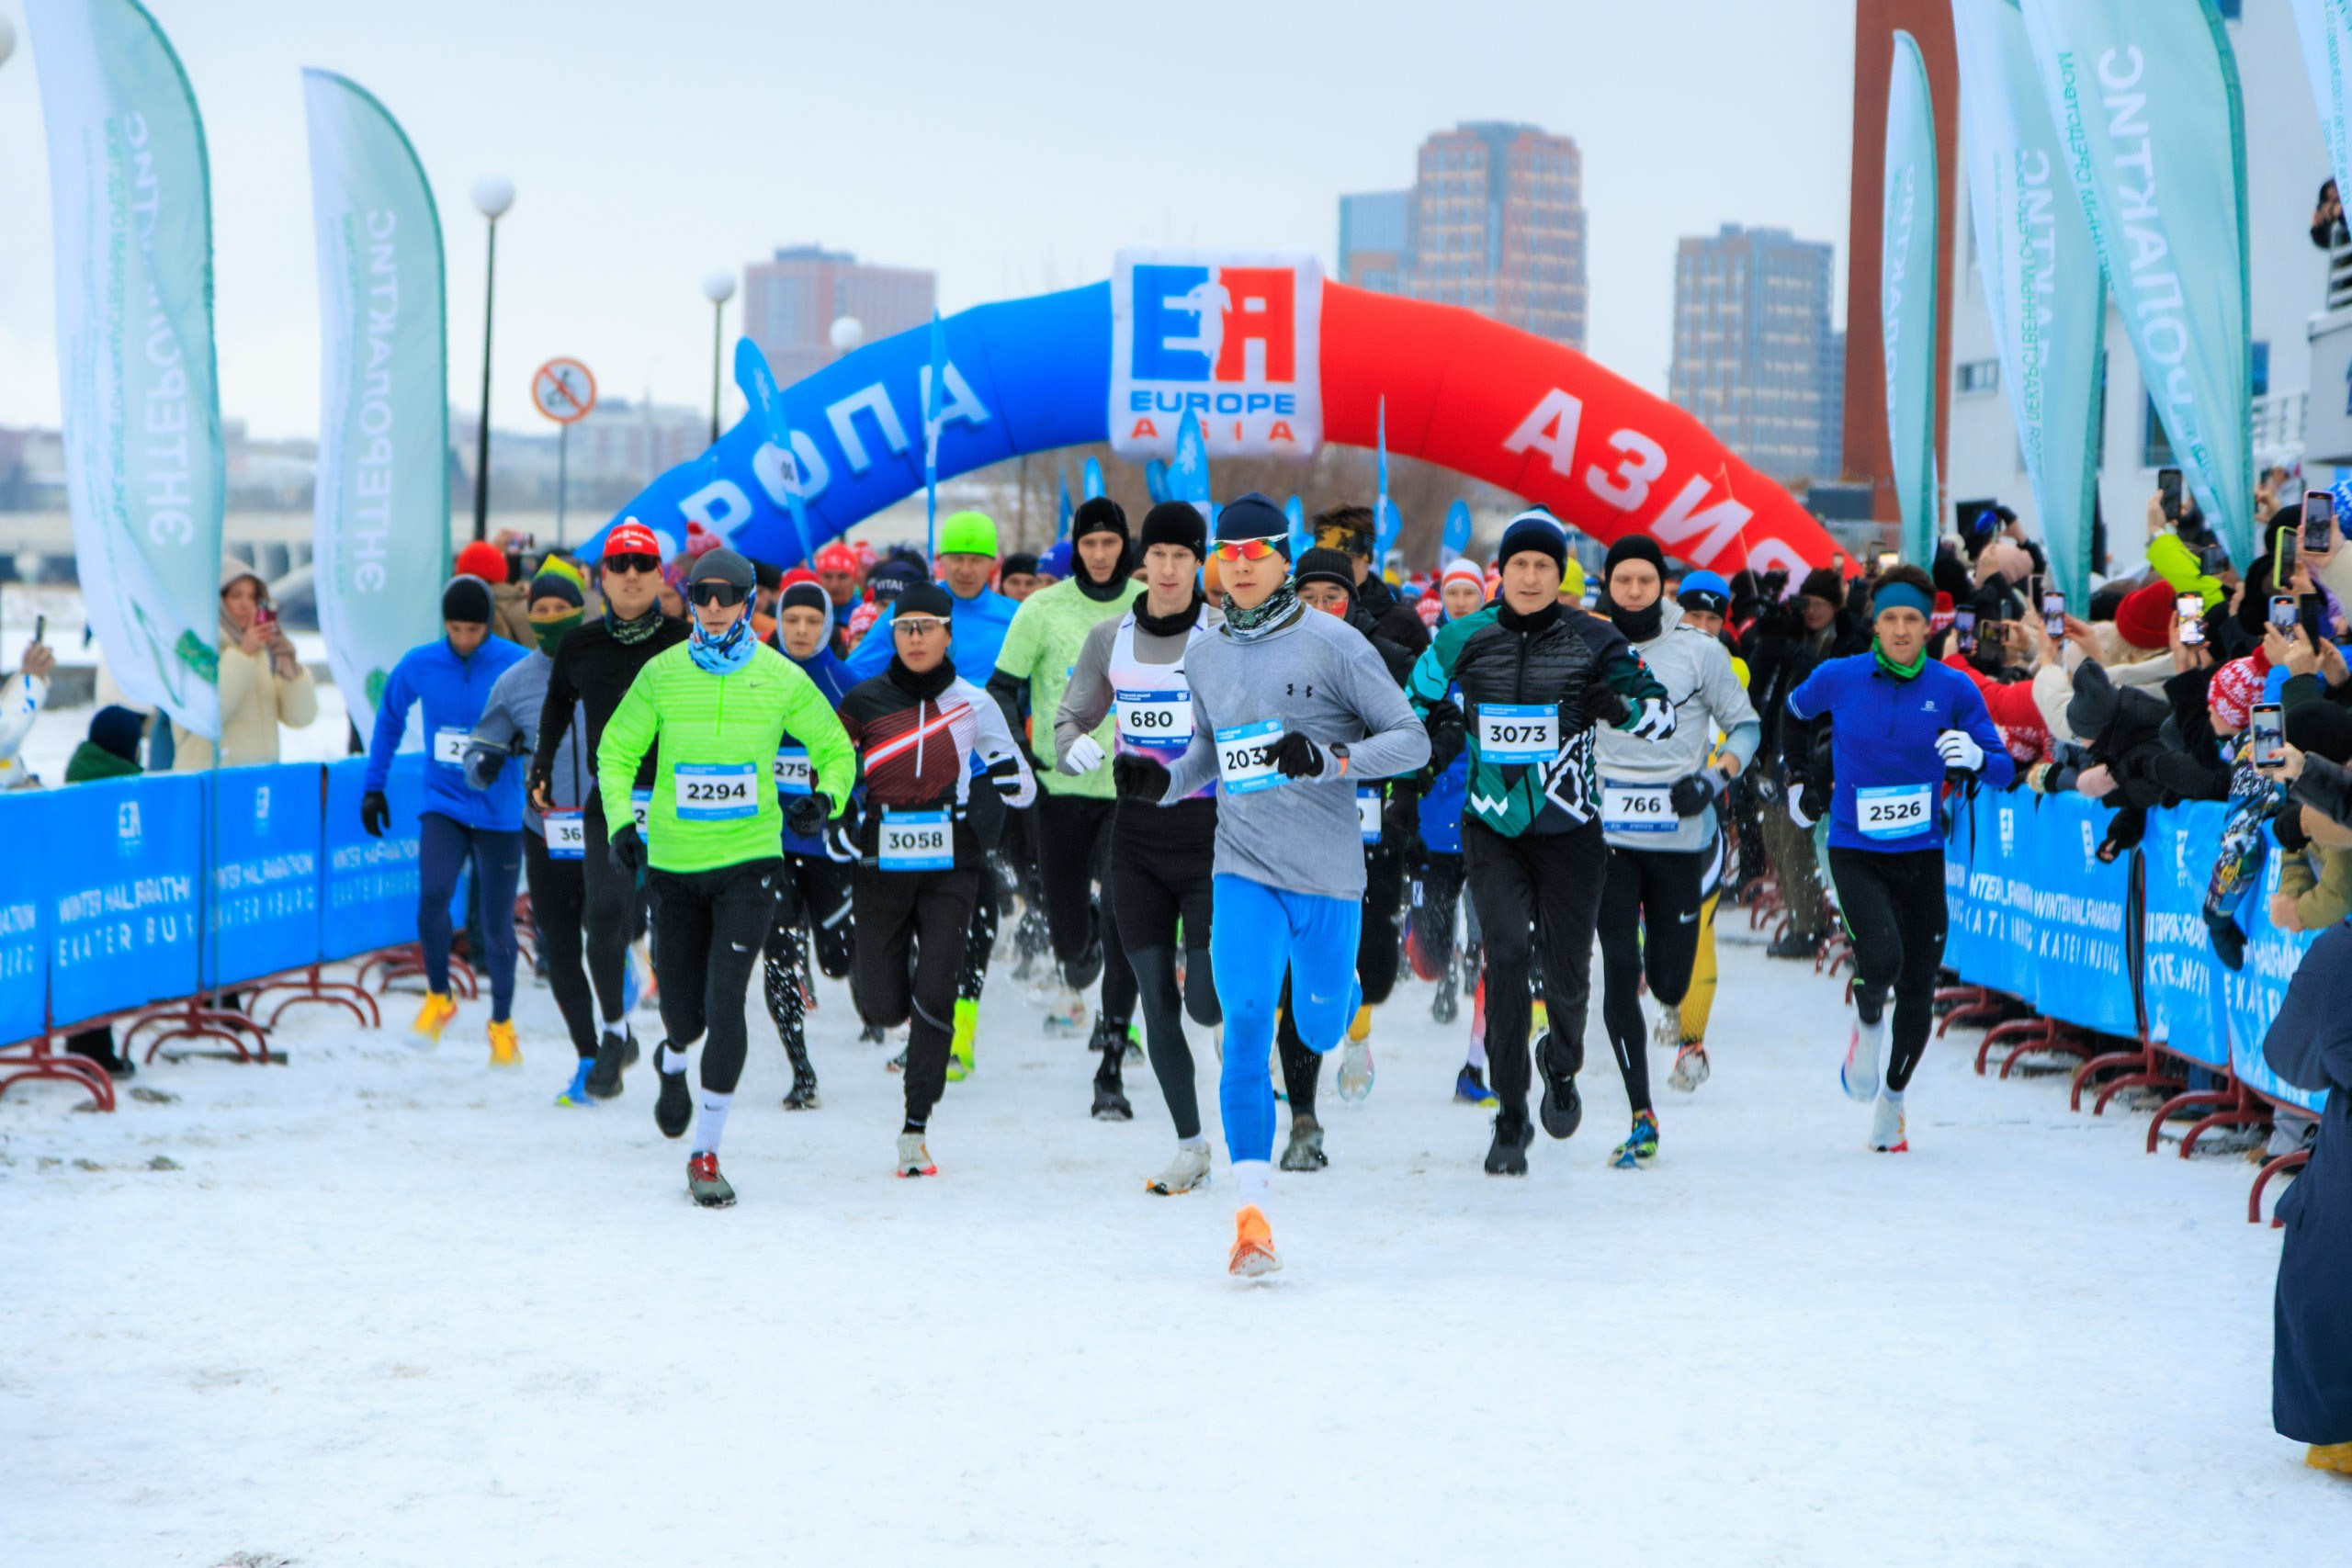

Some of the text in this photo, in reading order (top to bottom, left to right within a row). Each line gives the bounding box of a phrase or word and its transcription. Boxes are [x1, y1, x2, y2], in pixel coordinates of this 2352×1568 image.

[1130, 390, 1295, 415] EUROPE
[1131, 711, 1173, 728] 680
[1490, 726, 1546, 743] 3073
[1227, 746, 1266, 770] 203
[687, 782, 746, 800] 2294
[1623, 796, 1661, 813] 766
[1870, 800, 1921, 822] 2526
[889, 831, 943, 850] 3058
